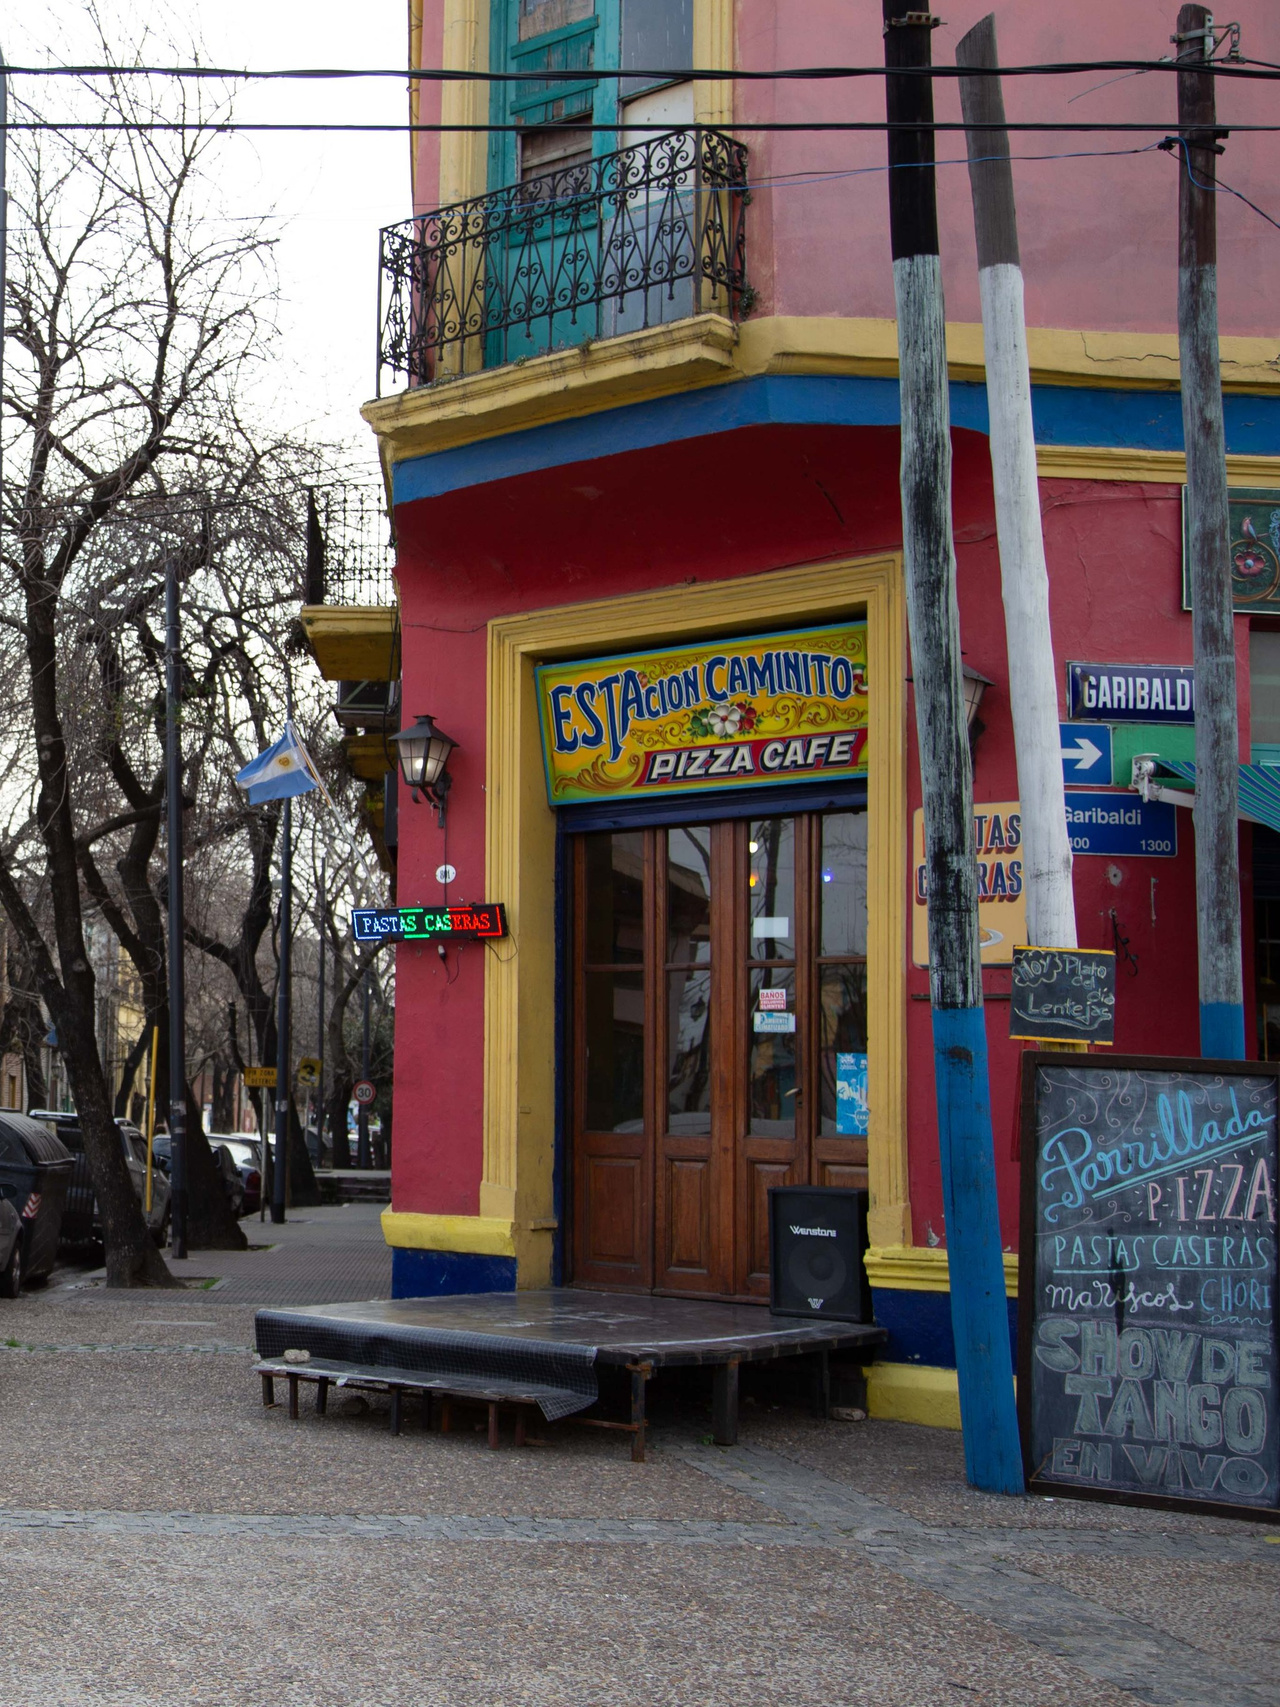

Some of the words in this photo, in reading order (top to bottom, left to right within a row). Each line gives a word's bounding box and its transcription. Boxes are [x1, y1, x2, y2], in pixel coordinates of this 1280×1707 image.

[705, 651, 856, 702] CAMINITO
[646, 748, 755, 784] PIZZA
[761, 732, 858, 775] CAFE
[1140, 839, 1171, 852] 1300
[362, 913, 418, 933] PASTAS
[424, 911, 491, 932] CASERAS
[1018, 955, 1052, 981] HOY
[1063, 954, 1107, 979] Plato
[1071, 976, 1095, 990] del
[1028, 993, 1112, 1025] Lentejas
[358, 1087, 371, 1098] 30
[1041, 1086, 1275, 1223] Parrillada
[1148, 1158, 1275, 1222] PIZZA
[789, 1225, 837, 1238] Wenstone
[1053, 1235, 1145, 1271] PASTAS
[1152, 1235, 1270, 1270] CASERAS
[1200, 1278, 1272, 1312] CHORI
[1200, 1314, 1273, 1326] pan
[1064, 1373, 1268, 1456] TANGO
[1051, 1438, 1112, 1482] EN
